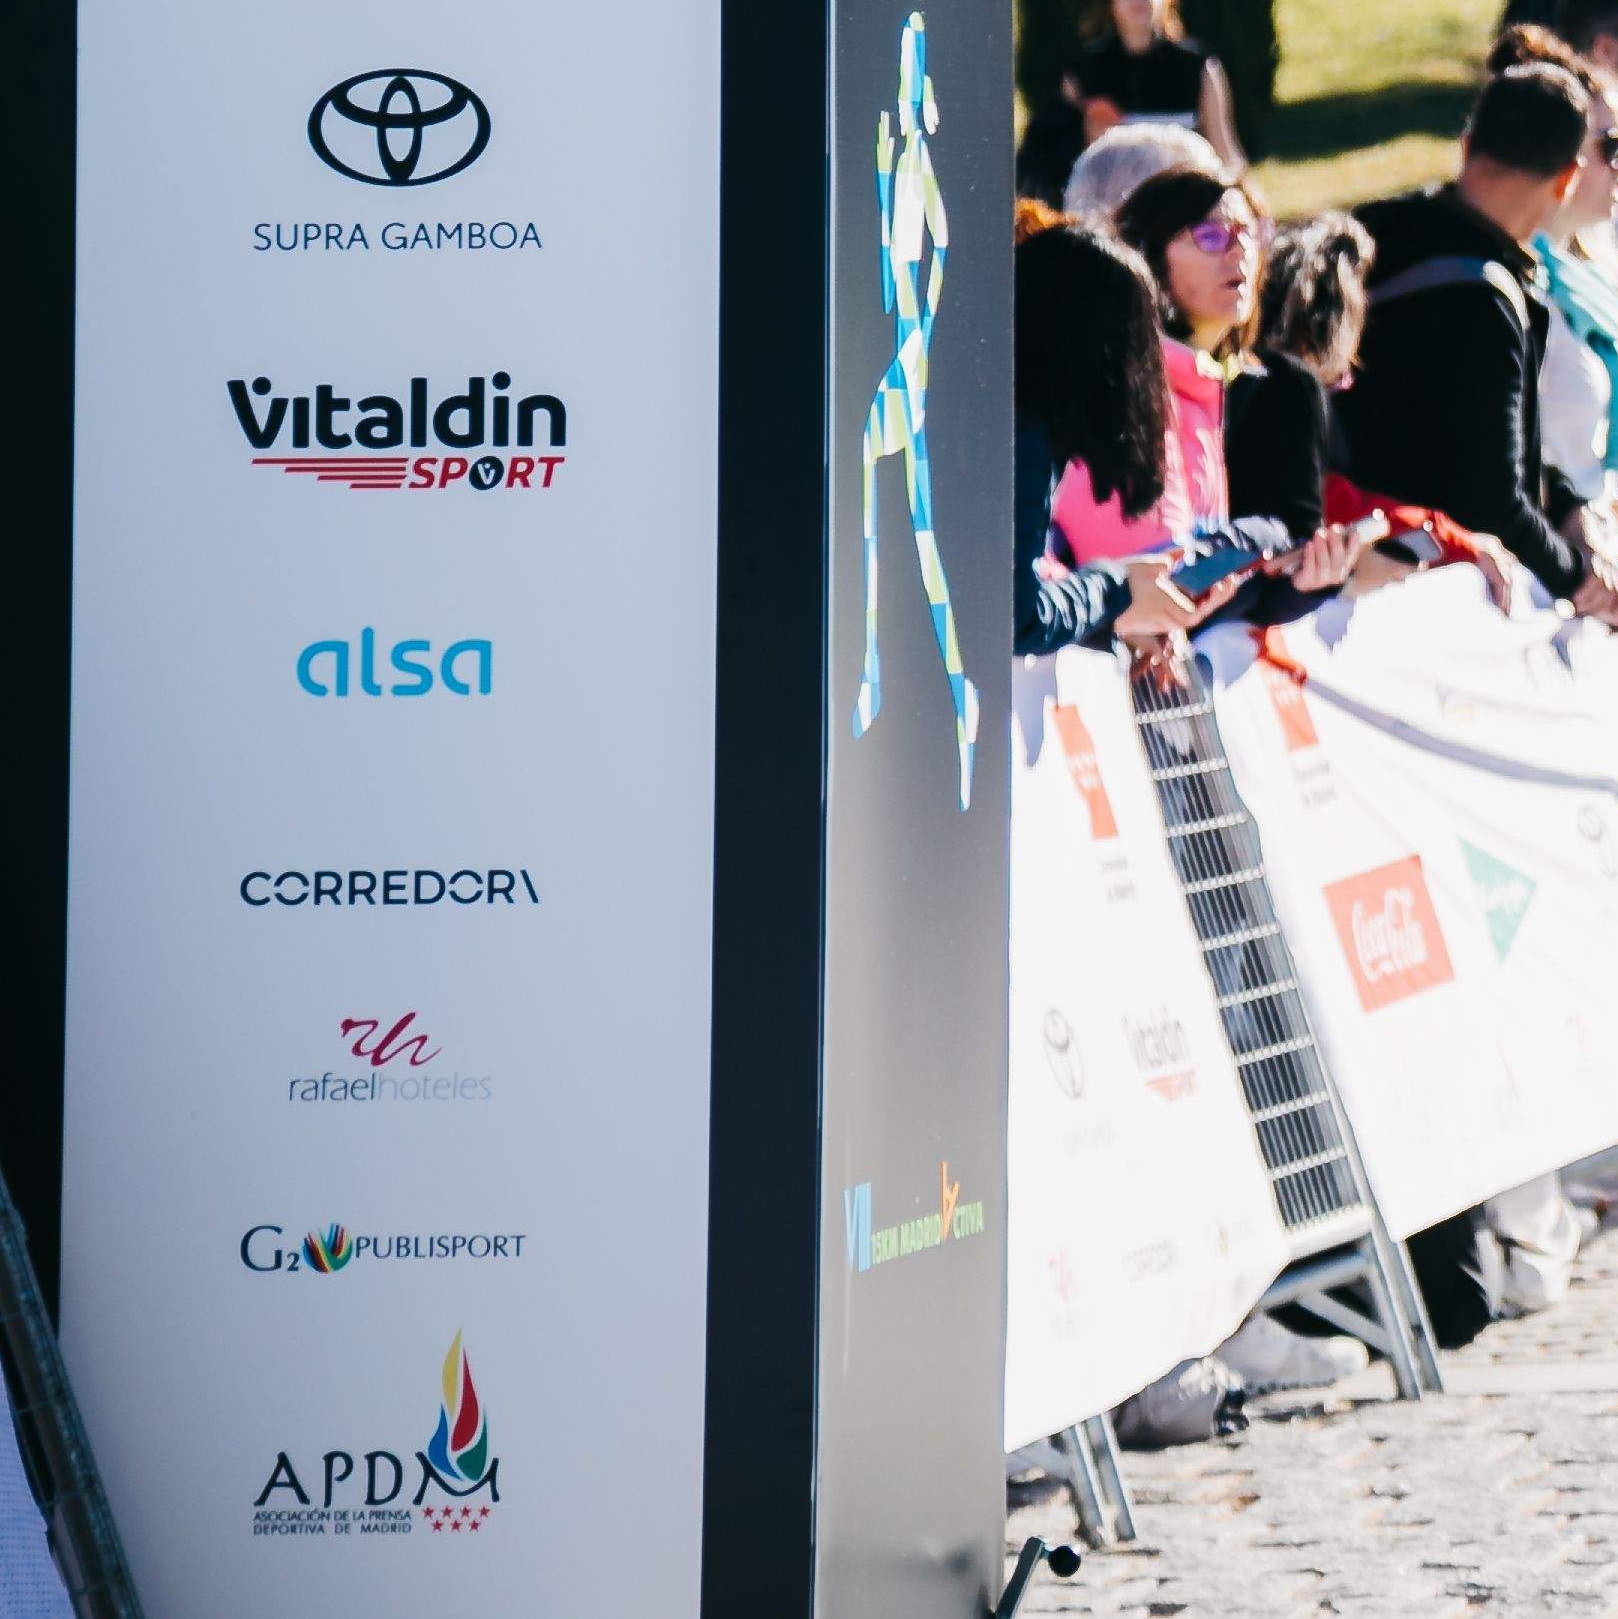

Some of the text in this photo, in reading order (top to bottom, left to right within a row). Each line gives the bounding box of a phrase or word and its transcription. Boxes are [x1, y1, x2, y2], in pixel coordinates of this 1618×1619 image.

[253, 221, 543, 251] SUPRA GAMBOA
[226, 370, 568, 450] Vitaldin
[407, 455, 566, 492] SPORT
[296, 625, 493, 698] alsa
[288, 1071, 493, 1102] rafaelhoteles
[239, 1224, 526, 1273] G2 PUBLISPORT
[252, 1449, 501, 1508] APDM
[253, 1507, 412, 1523] ASOCIACIÓN DE LA PRENSA
[253, 1522, 412, 1536] DEPORTIVA DE MADRID
